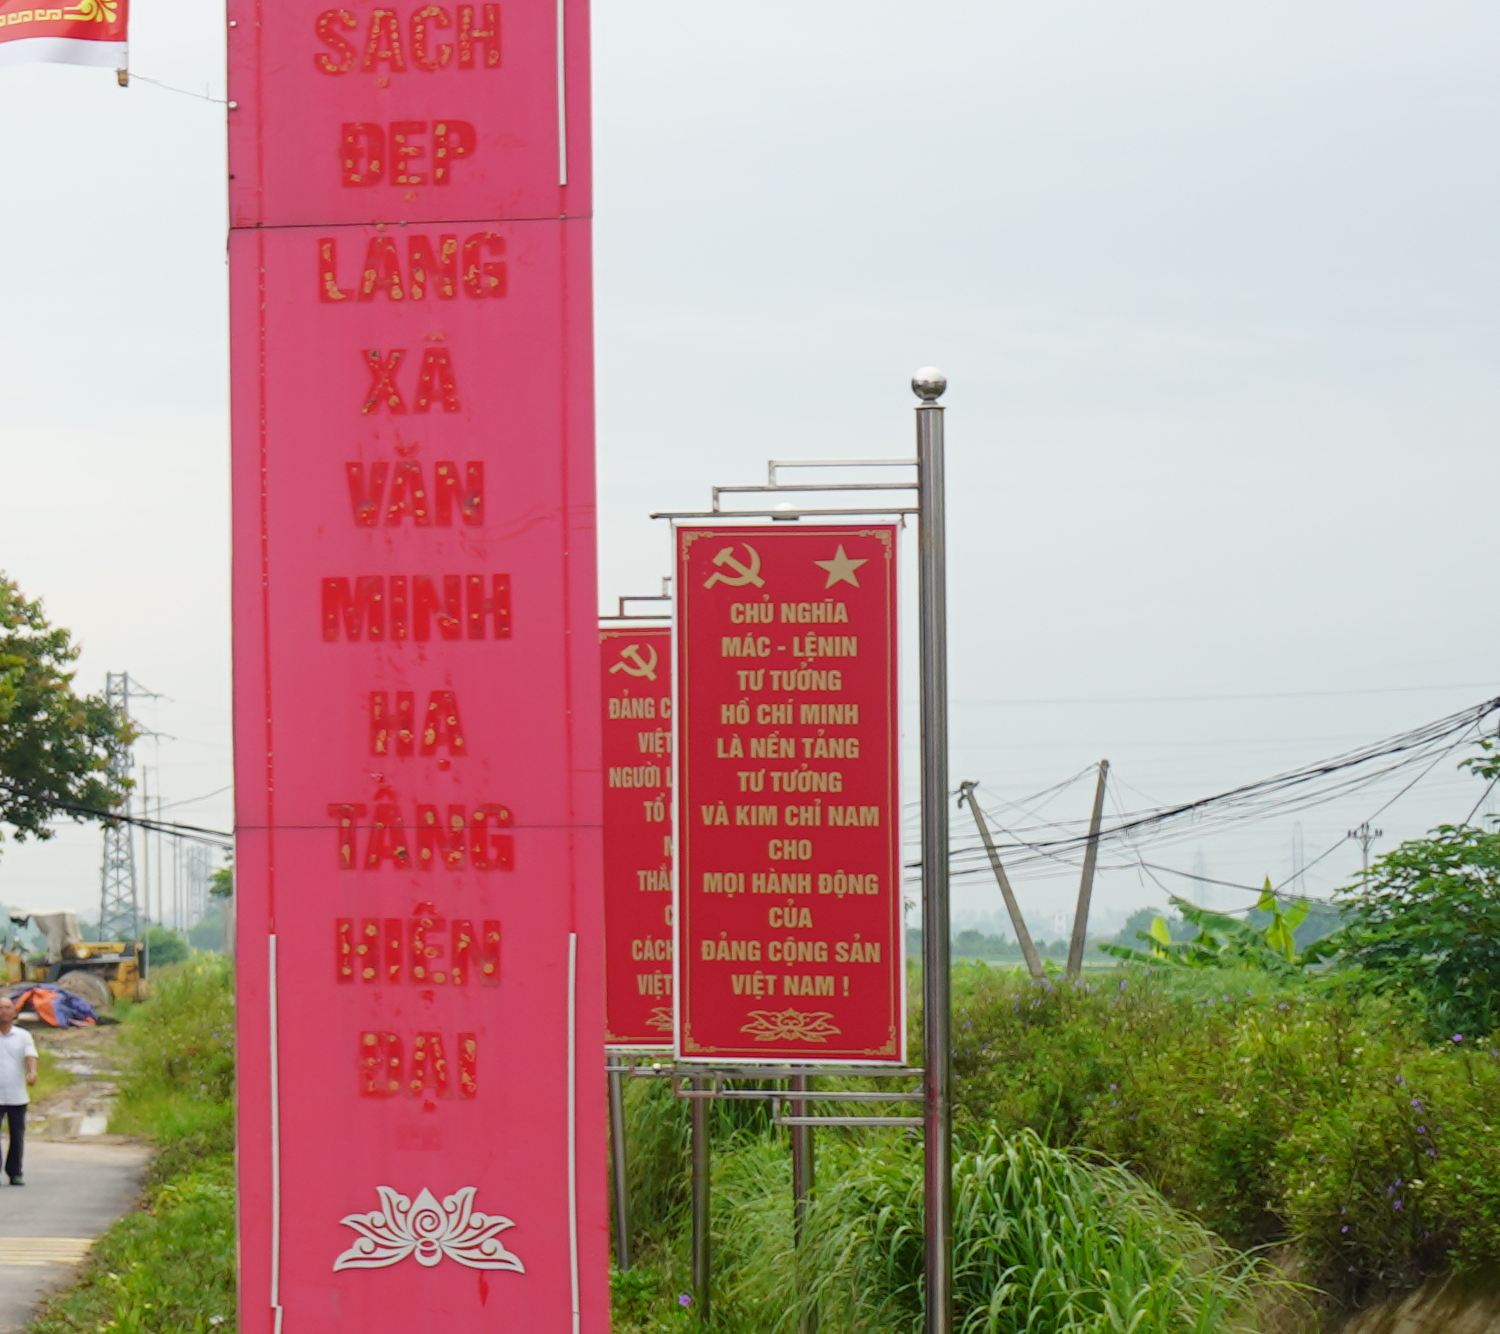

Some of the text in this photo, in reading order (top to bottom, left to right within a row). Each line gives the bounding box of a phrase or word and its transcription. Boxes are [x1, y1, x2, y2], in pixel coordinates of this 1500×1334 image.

[314, 3, 503, 88] SẠCH
[338, 119, 477, 201] ĐẸP
[345, 441, 485, 529] VĂN
[320, 572, 512, 643] MINH
[730, 593, 848, 624] CHỦ NGHĨA
[721, 632, 771, 657] MÁC
[737, 662, 842, 691] TƯ TƯỞNG
[608, 689, 655, 719] ĐẢNG
[721, 697, 859, 725] HỒ CHÍ MINH
[369, 690, 468, 771] HẠ
[717, 728, 860, 758] LÀ NỀN TẢNG
[609, 761, 661, 788] NGƯỜI
[737, 763, 842, 792] TƯ TƯỞNG
[701, 798, 880, 827] VÀ KIM CHỈ NAM
[768, 839, 812, 860] CHO
[703, 868, 879, 899] MỌI HÀNH ĐỘNG
[769, 898, 813, 928] CỦA
[335, 902, 502, 1002] HIỆN
[701, 931, 881, 966] ĐẢNG CỘNG SẢN
[636, 969, 673, 1000] VIỆT
[731, 970, 850, 1000] VIỆT NAM !
